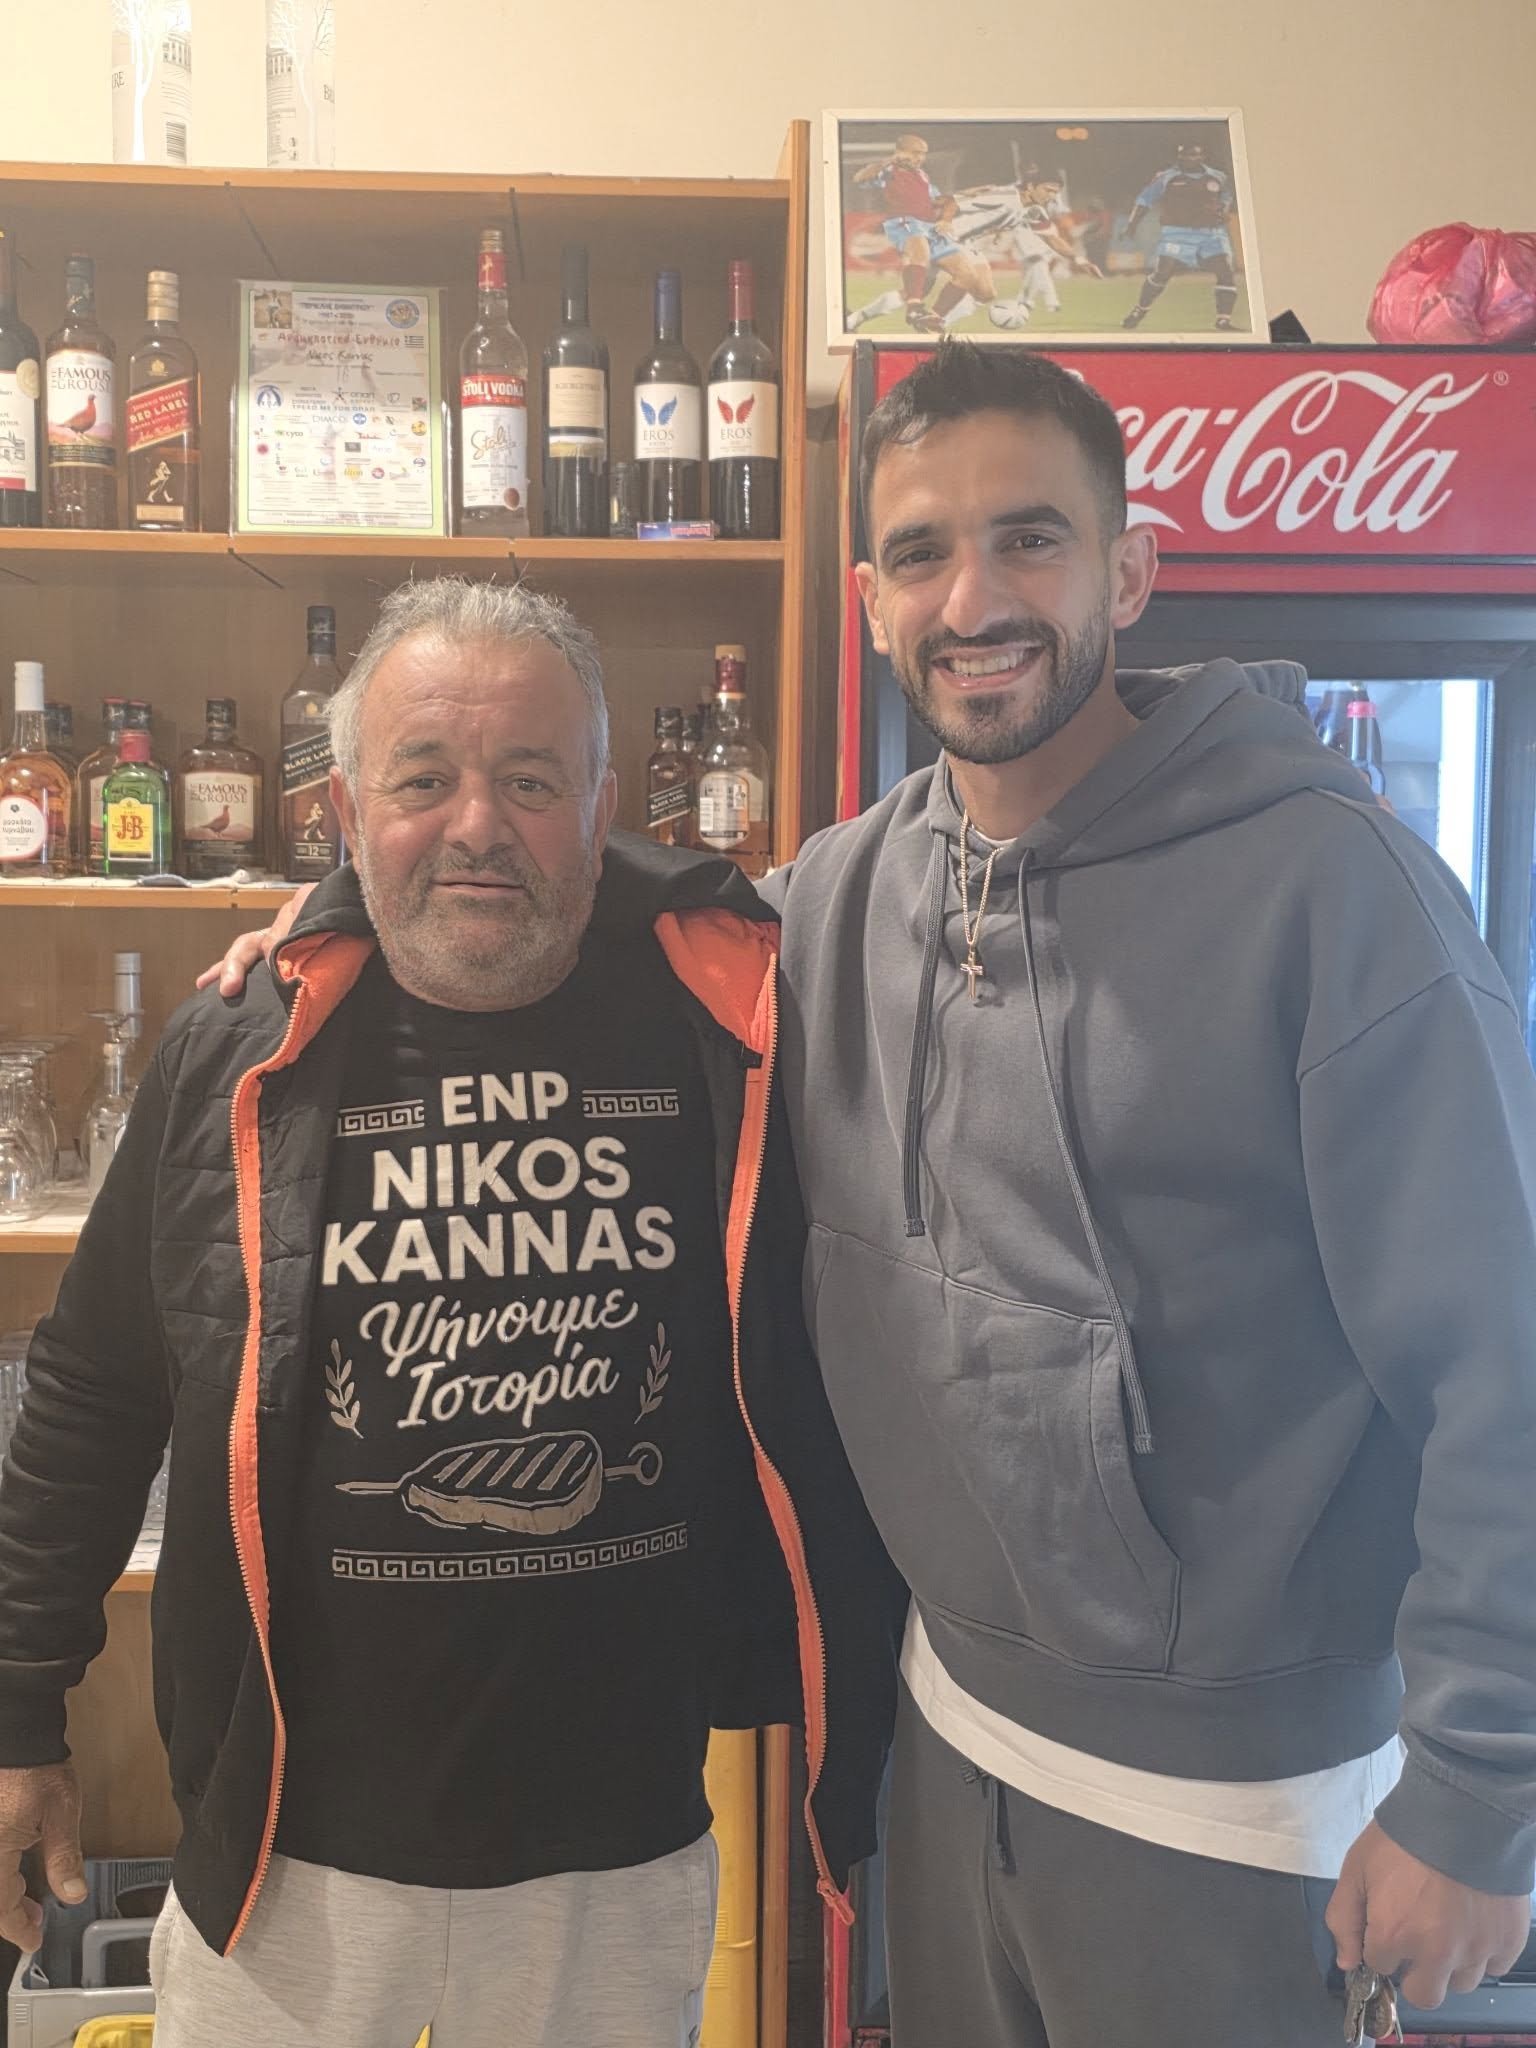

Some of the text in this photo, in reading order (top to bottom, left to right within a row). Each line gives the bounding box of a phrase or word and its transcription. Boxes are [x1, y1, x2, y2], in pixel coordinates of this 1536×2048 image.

[58, 367, 112, 381] FAMOUS
[463, 381, 524, 397] STOLI VODKA
[129, 409, 152, 424] RED
[154, 397, 189, 416] LABEL
[643, 430, 675, 441] EROS
[720, 427, 753, 441] EROS
[283, 755, 313, 771] BLACK
[199, 783, 247, 794] FAMOUS
[308, 845, 320, 857] 12
[441, 1071, 569, 1126] ENP
[372, 1136, 631, 1211] NIKOS
[322, 1206, 677, 1285] KANNAS
[359, 1288, 639, 1377] Ψήνουμε
[397, 1341, 620, 1428] Ιστορία
